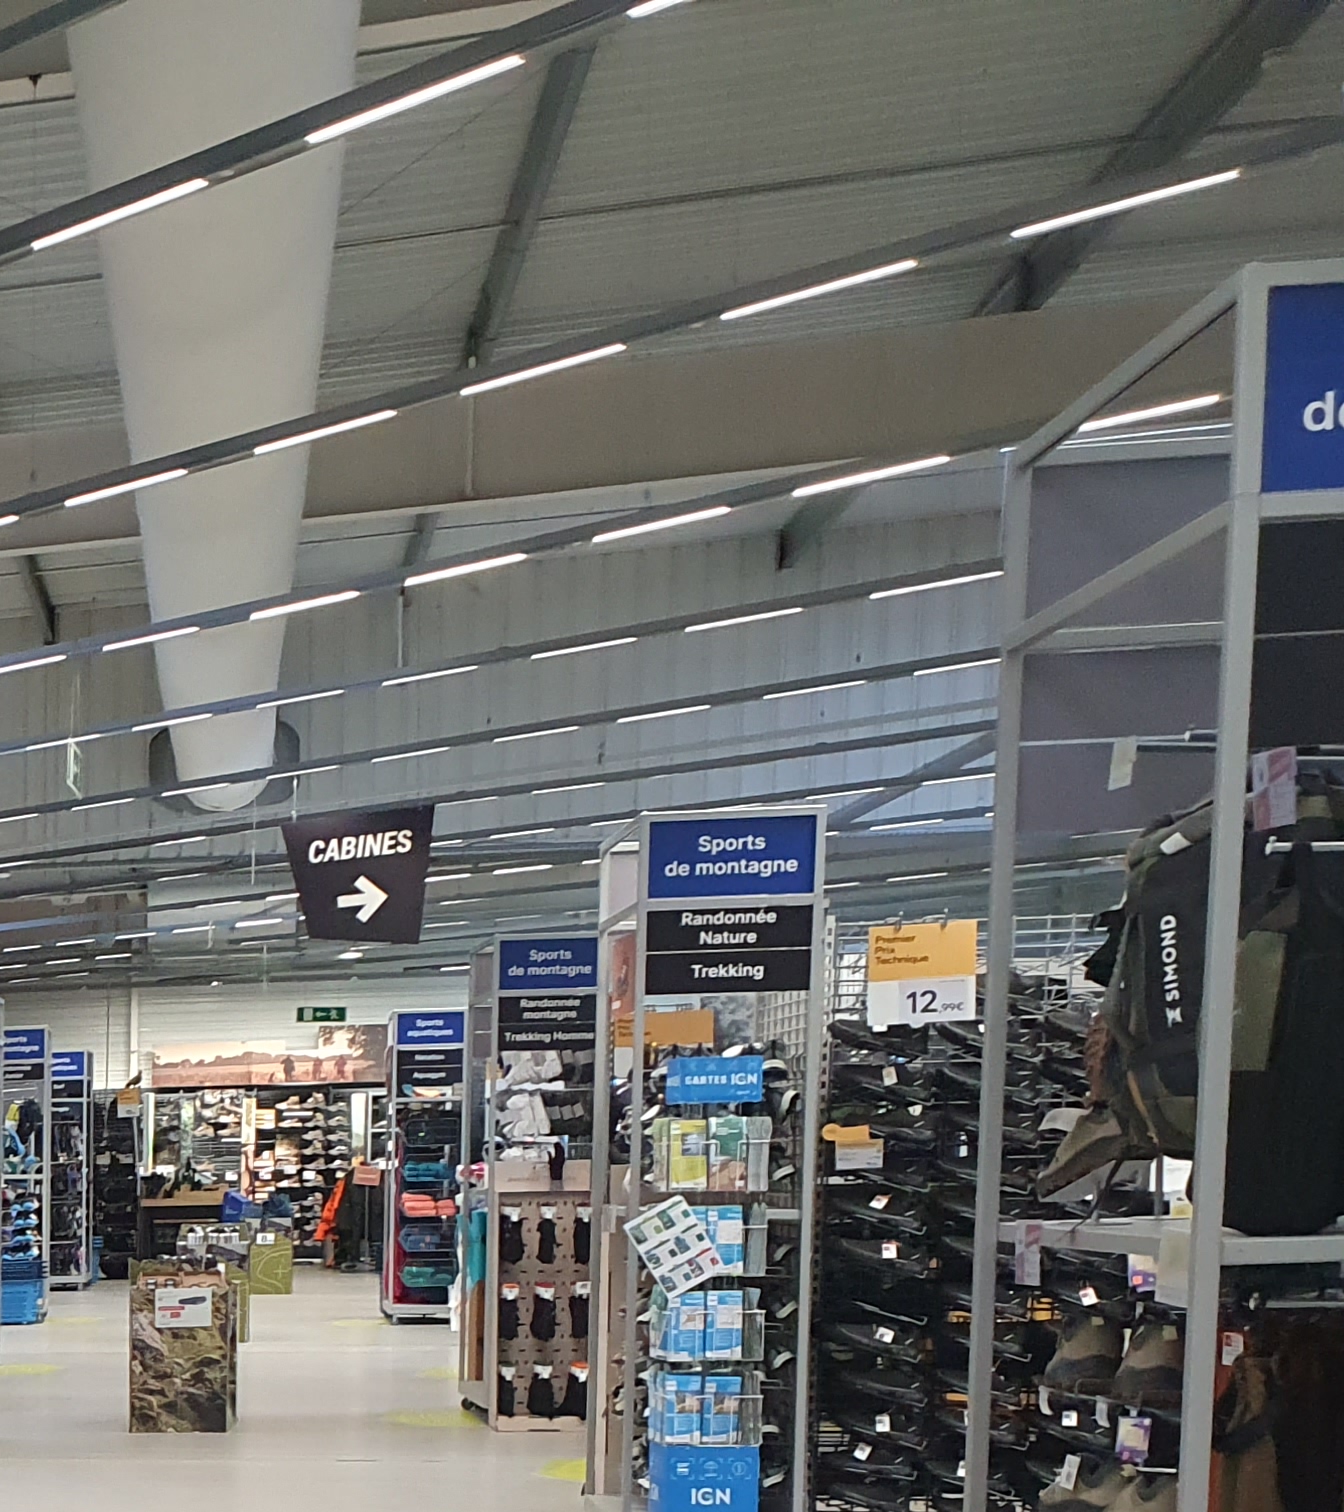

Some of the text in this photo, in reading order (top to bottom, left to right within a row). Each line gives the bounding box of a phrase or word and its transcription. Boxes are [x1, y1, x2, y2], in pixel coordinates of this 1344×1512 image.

[308, 829, 413, 863] CABINES
[698, 835, 766, 855] Sports
[664, 859, 798, 877] de montagne
[681, 909, 777, 926] Randonnée
[699, 931, 757, 945] Nature
[529, 949, 572, 962] Sports
[1160, 914, 1181, 1002] SIMOND
[507, 965, 592, 977] de montagne
[691, 963, 765, 979] Trekking
[504, 1032, 551, 1043] Trekking
[731, 1073, 758, 1085] IGN
[691, 1487, 731, 1505] IGN
